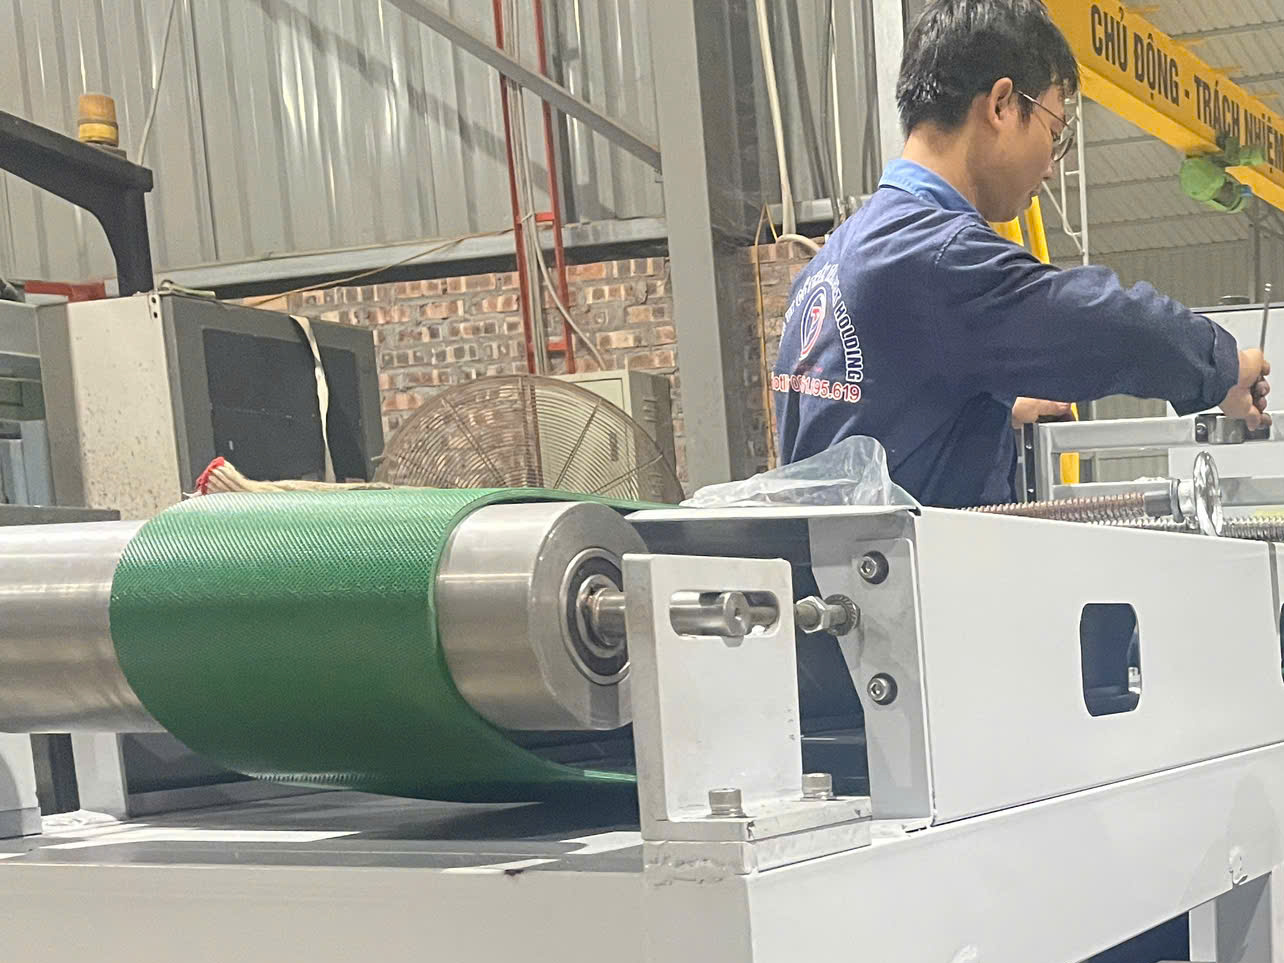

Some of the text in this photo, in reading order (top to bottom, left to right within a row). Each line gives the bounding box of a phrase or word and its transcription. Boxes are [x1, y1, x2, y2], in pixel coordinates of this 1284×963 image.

[1090, 4, 1128, 72] CHỦ
[1133, 33, 1180, 106] ĐỘNG
[1194, 74, 1241, 139] TRÁCH
[1244, 109, 1284, 173] NHIỆM
[834, 301, 863, 382] HOLDING
